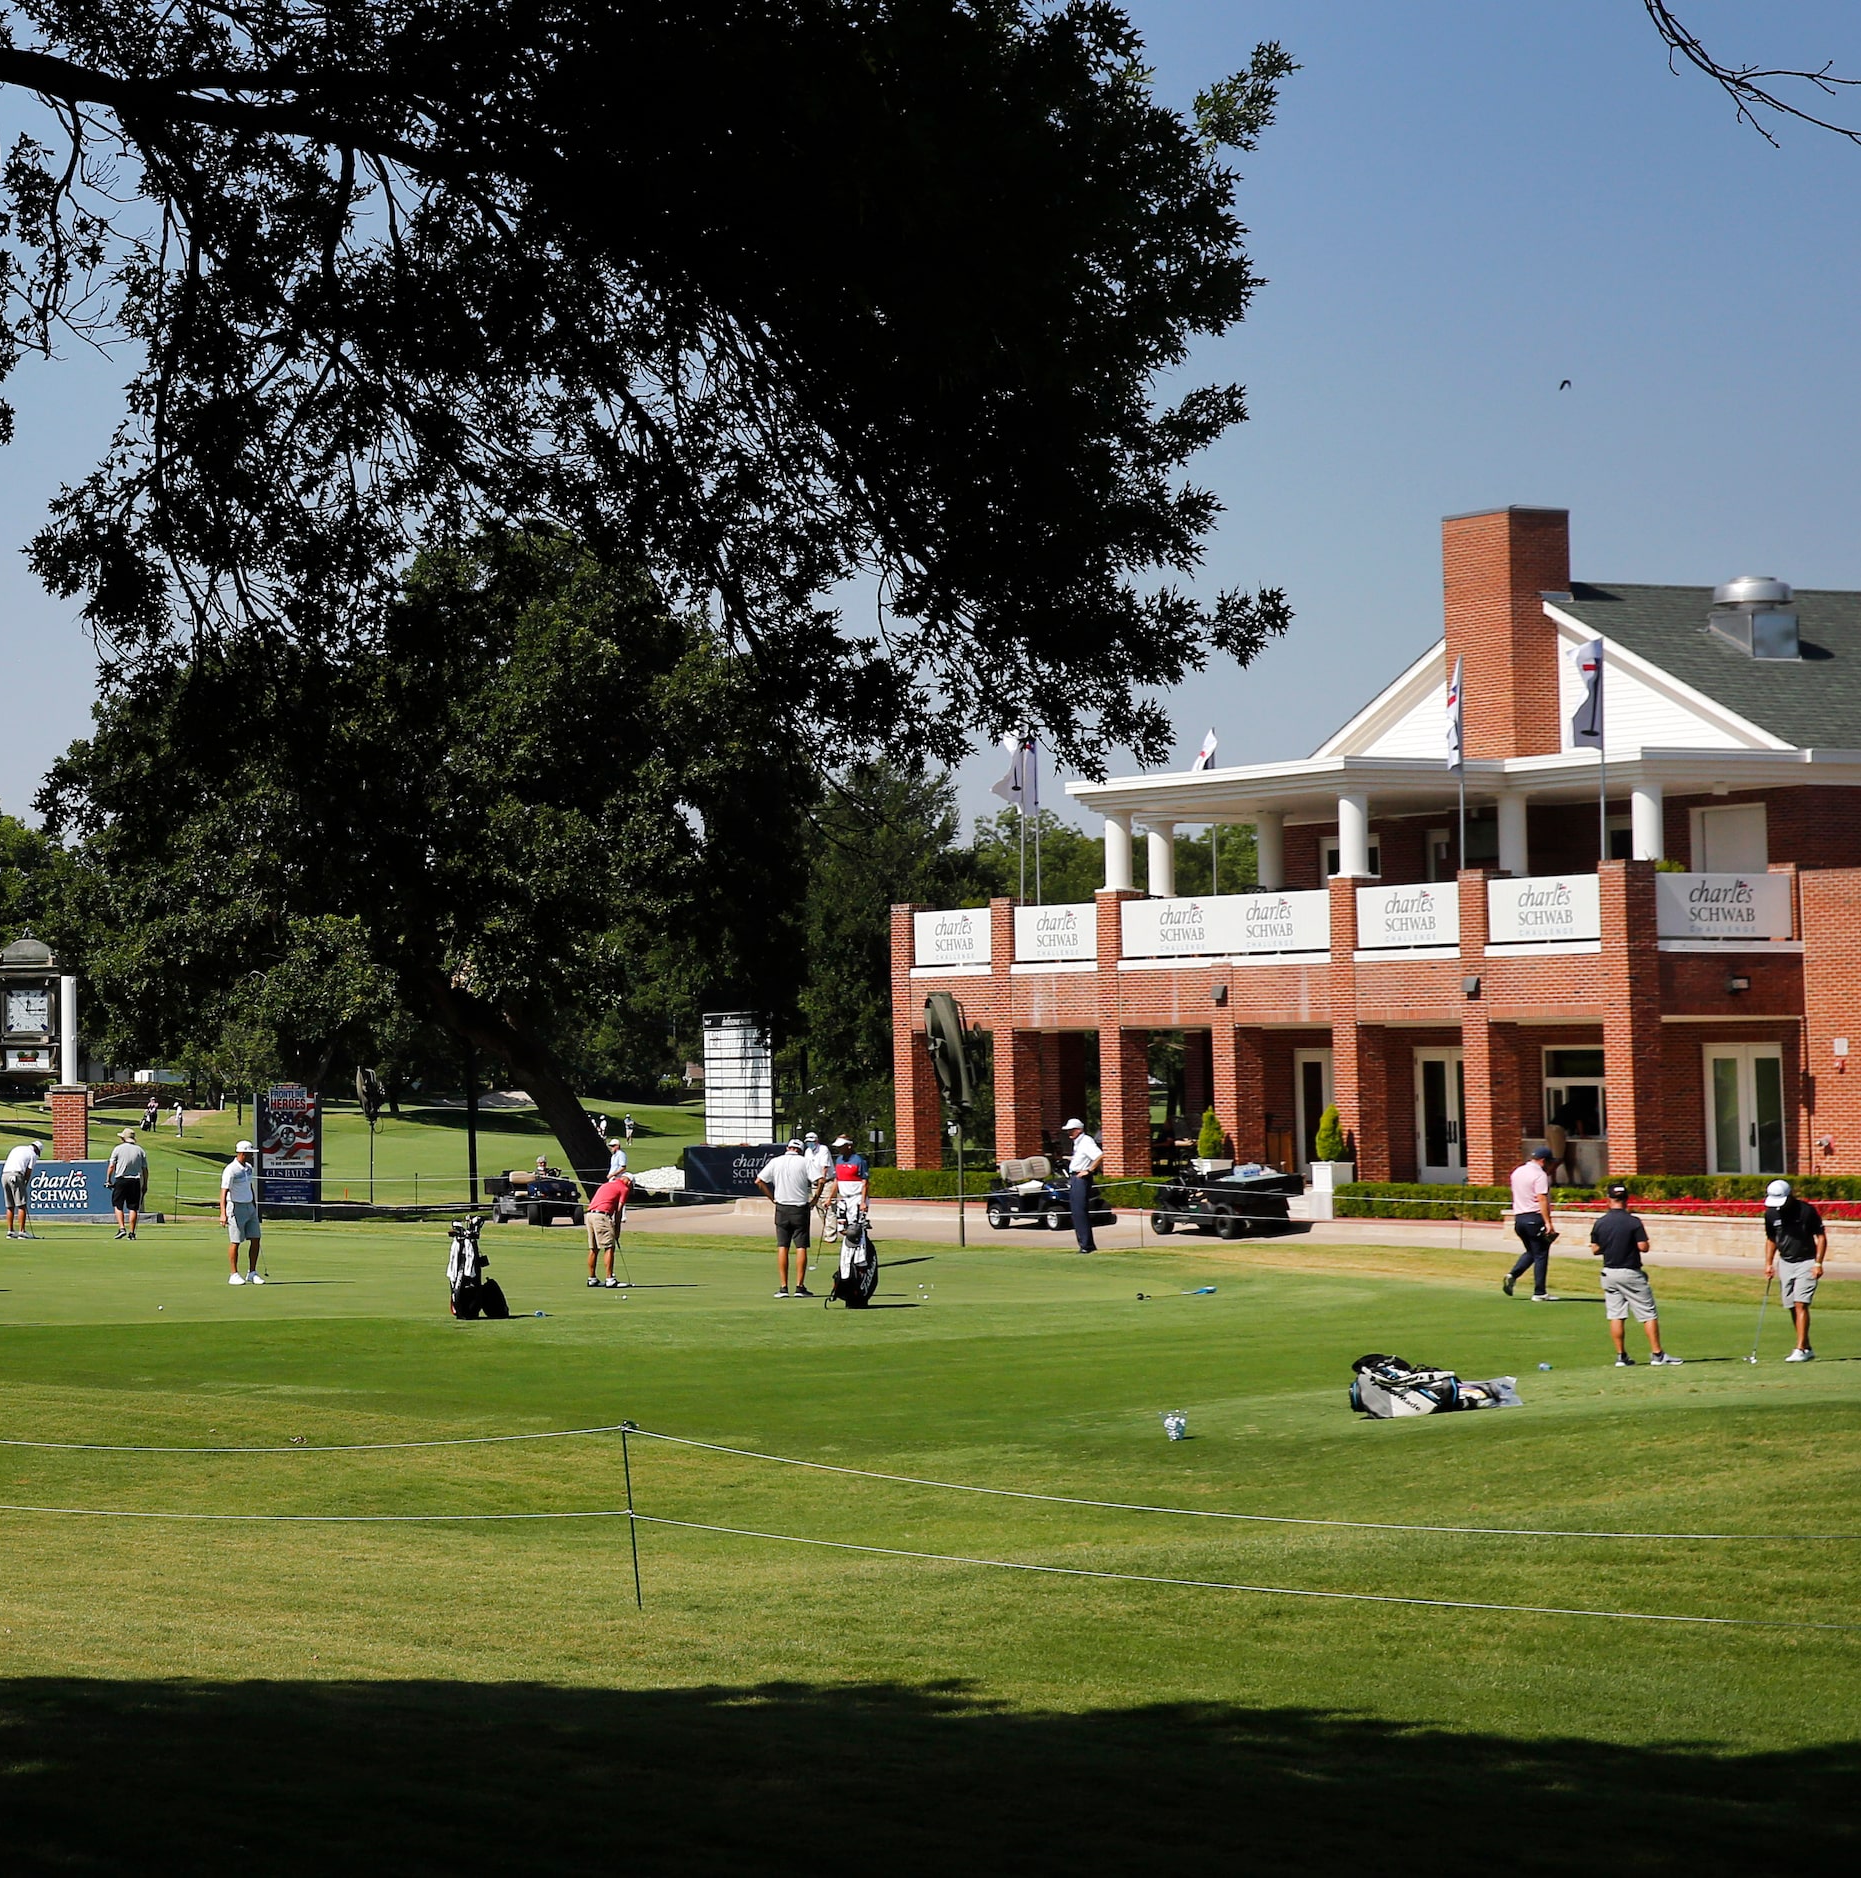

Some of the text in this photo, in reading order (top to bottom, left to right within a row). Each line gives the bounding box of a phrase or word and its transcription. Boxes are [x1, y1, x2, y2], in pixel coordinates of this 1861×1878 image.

[1518, 882, 1572, 908] charles
[1689, 879, 1754, 903] charles
[1246, 898, 1292, 921] charles
[1385, 890, 1435, 914] charles
[1036, 910, 1077, 931] charles
[1160, 903, 1203, 925] charles
[1518, 909, 1573, 926] SCHWAB
[1689, 907, 1755, 922] SCHWAB
[934, 914, 972, 936] charles
[1246, 923, 1293, 938] SCHWAB
[1385, 916, 1436, 932] SCHWAB
[1036, 933, 1078, 947] SCHWAB
[1160, 927, 1205, 942] SCHWAB
[935, 938, 974, 951] SCHWAB
[271, 1099, 305, 1110] HEROES
[30, 1169, 87, 1188] charles
[30, 1190, 88, 1201] SCHWAB
